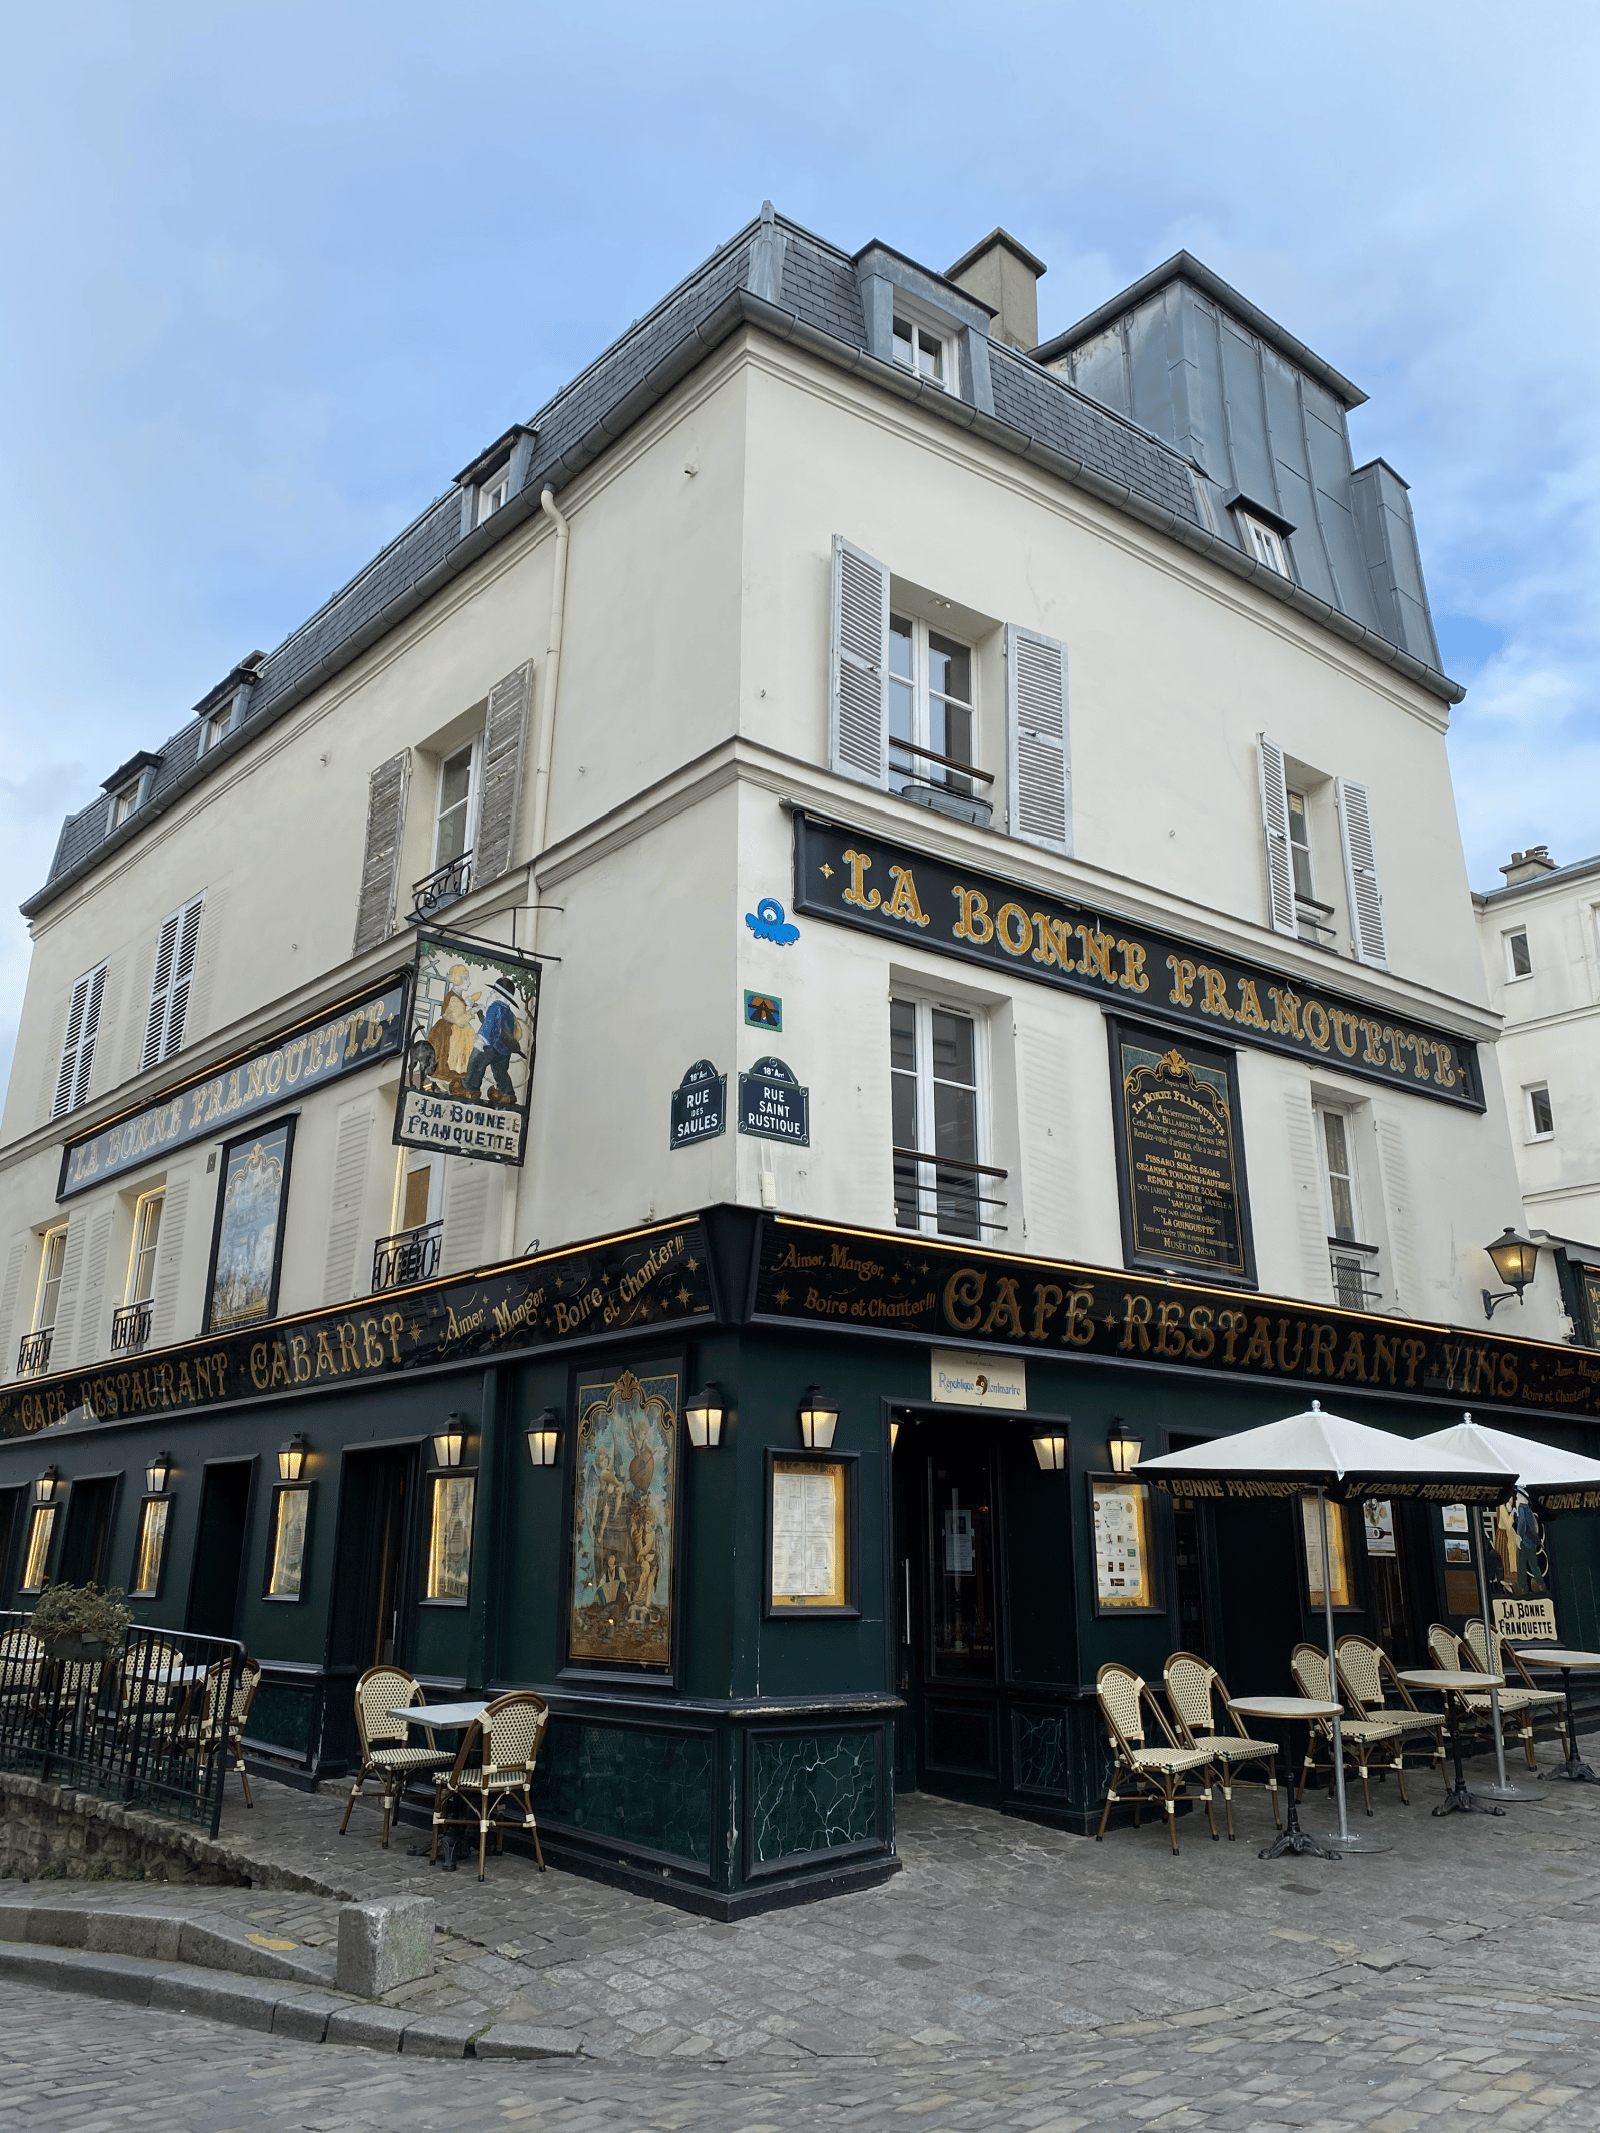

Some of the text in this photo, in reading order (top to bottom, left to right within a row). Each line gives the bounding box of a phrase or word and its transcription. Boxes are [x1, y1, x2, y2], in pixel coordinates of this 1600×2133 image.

[842, 848, 1457, 1088] LA BONNE FRANQUETTE
[73, 1000, 385, 1182] LA BONNE FRANQUETTE
[686, 1089, 710, 1109] RUE
[763, 1086, 785, 1103] RUE
[418, 1098, 442, 1119] LA
[450, 1104, 506, 1130] BONNE
[690, 1107, 704, 1117] DES
[759, 1100, 790, 1118] SAINT
[1132, 1090, 1225, 1136] LA BONNE FRANQUETTE
[406, 1115, 515, 1152] FRANQUETTE
[677, 1113, 718, 1137] SAULES
[748, 1112, 801, 1135] RUSTIQUE
[1147, 1121, 1169, 1135] auberge
[1169, 1128, 1178, 1136] est
[1197, 1134, 1215, 1145] depuis
[1190, 1123, 1199, 1132] EN
[1137, 1183, 1150, 1192] SON
[1152, 1205, 1167, 1214] pour
[770, 1243, 885, 1282] Aimer, Manger,
[553, 1235, 685, 1335] Boire et Chanter!!!
[803, 1287, 937, 1317] Boire et Chanter!!!
[437, 1286, 548, 1352] Aimer, Manger,
[943, 1268, 1519, 1397] CAFÉ RESTAURANT VINS
[21, 1311, 405, 1431] CAFÉ RESTAURANT CABARET
[1521, 1383, 1543, 1402] Boire
[1544, 1389, 1554, 1403] et
[1171, 1479, 1225, 1497] BONNE
[1502, 1601, 1545, 1620] LA BONNE
[1498, 1619, 1553, 1637] FRANQUETTE
